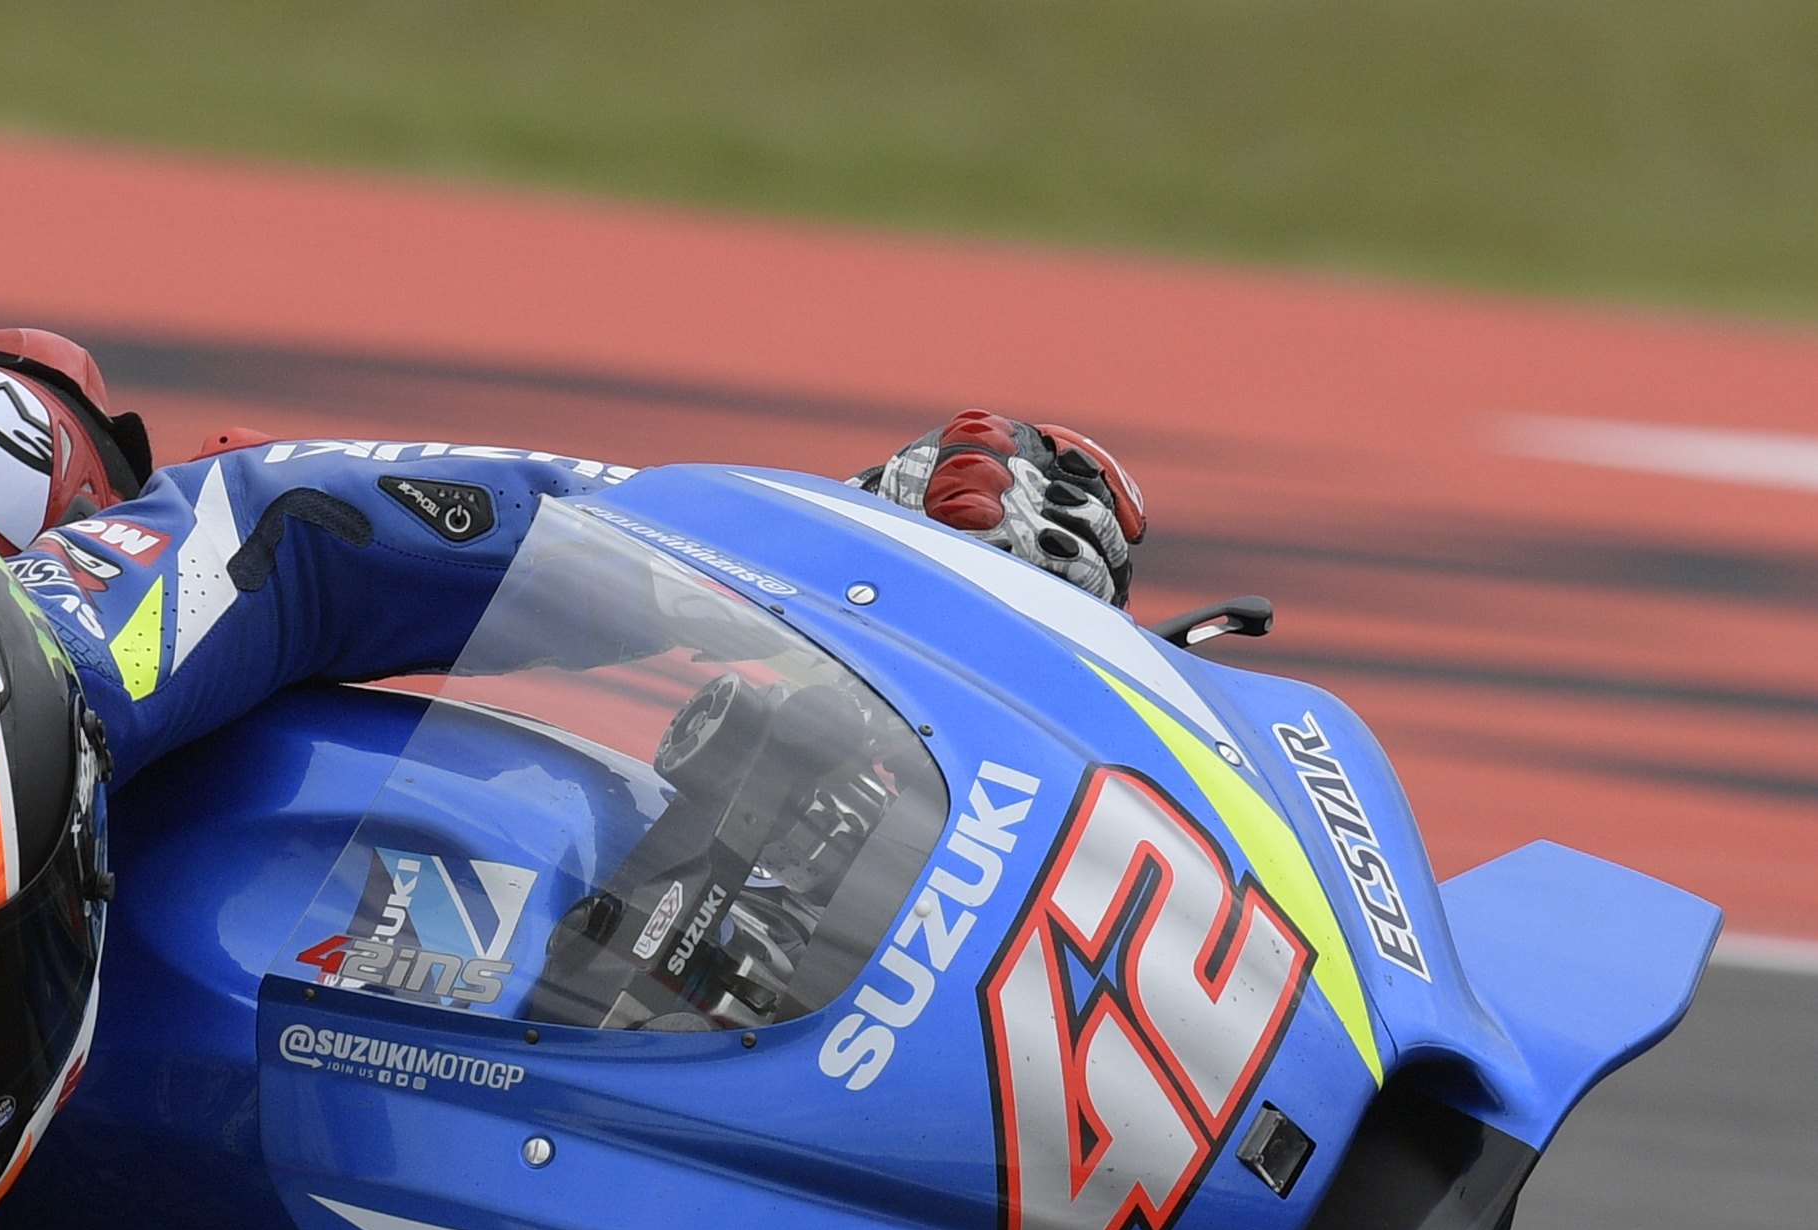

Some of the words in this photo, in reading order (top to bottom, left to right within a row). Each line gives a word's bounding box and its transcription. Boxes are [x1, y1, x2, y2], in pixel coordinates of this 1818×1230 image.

[1272, 710, 1433, 985] ECSTAR
[667, 883, 728, 976] SUZUKI
[818, 760, 1042, 1091] SUZUKI
[279, 1023, 526, 1091] @SUZUKIMOTOGP
[326, 1060, 354, 1075] JOIN
[358, 1066, 375, 1079] US
